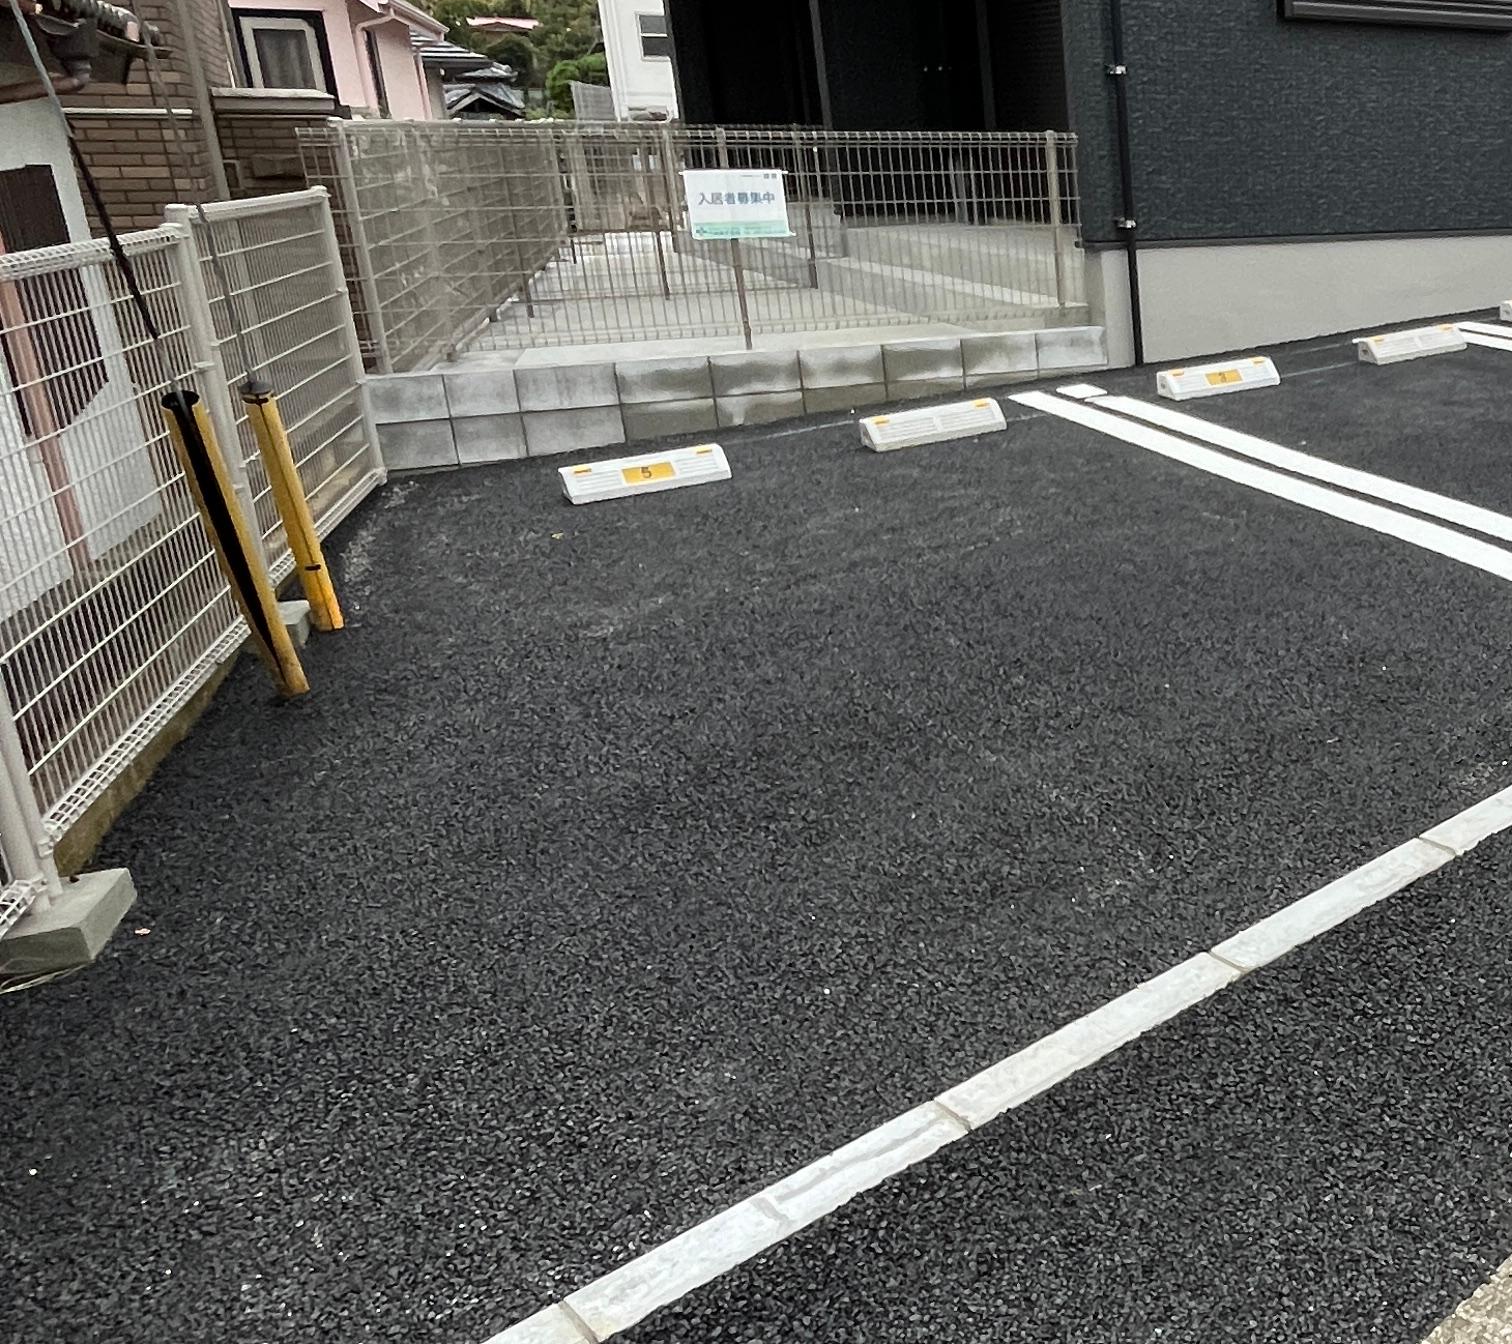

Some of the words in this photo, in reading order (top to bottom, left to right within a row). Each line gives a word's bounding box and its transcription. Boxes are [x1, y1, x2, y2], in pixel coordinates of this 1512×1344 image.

[698, 191, 775, 205] 入居者募集中
[640, 466, 652, 479] 5
